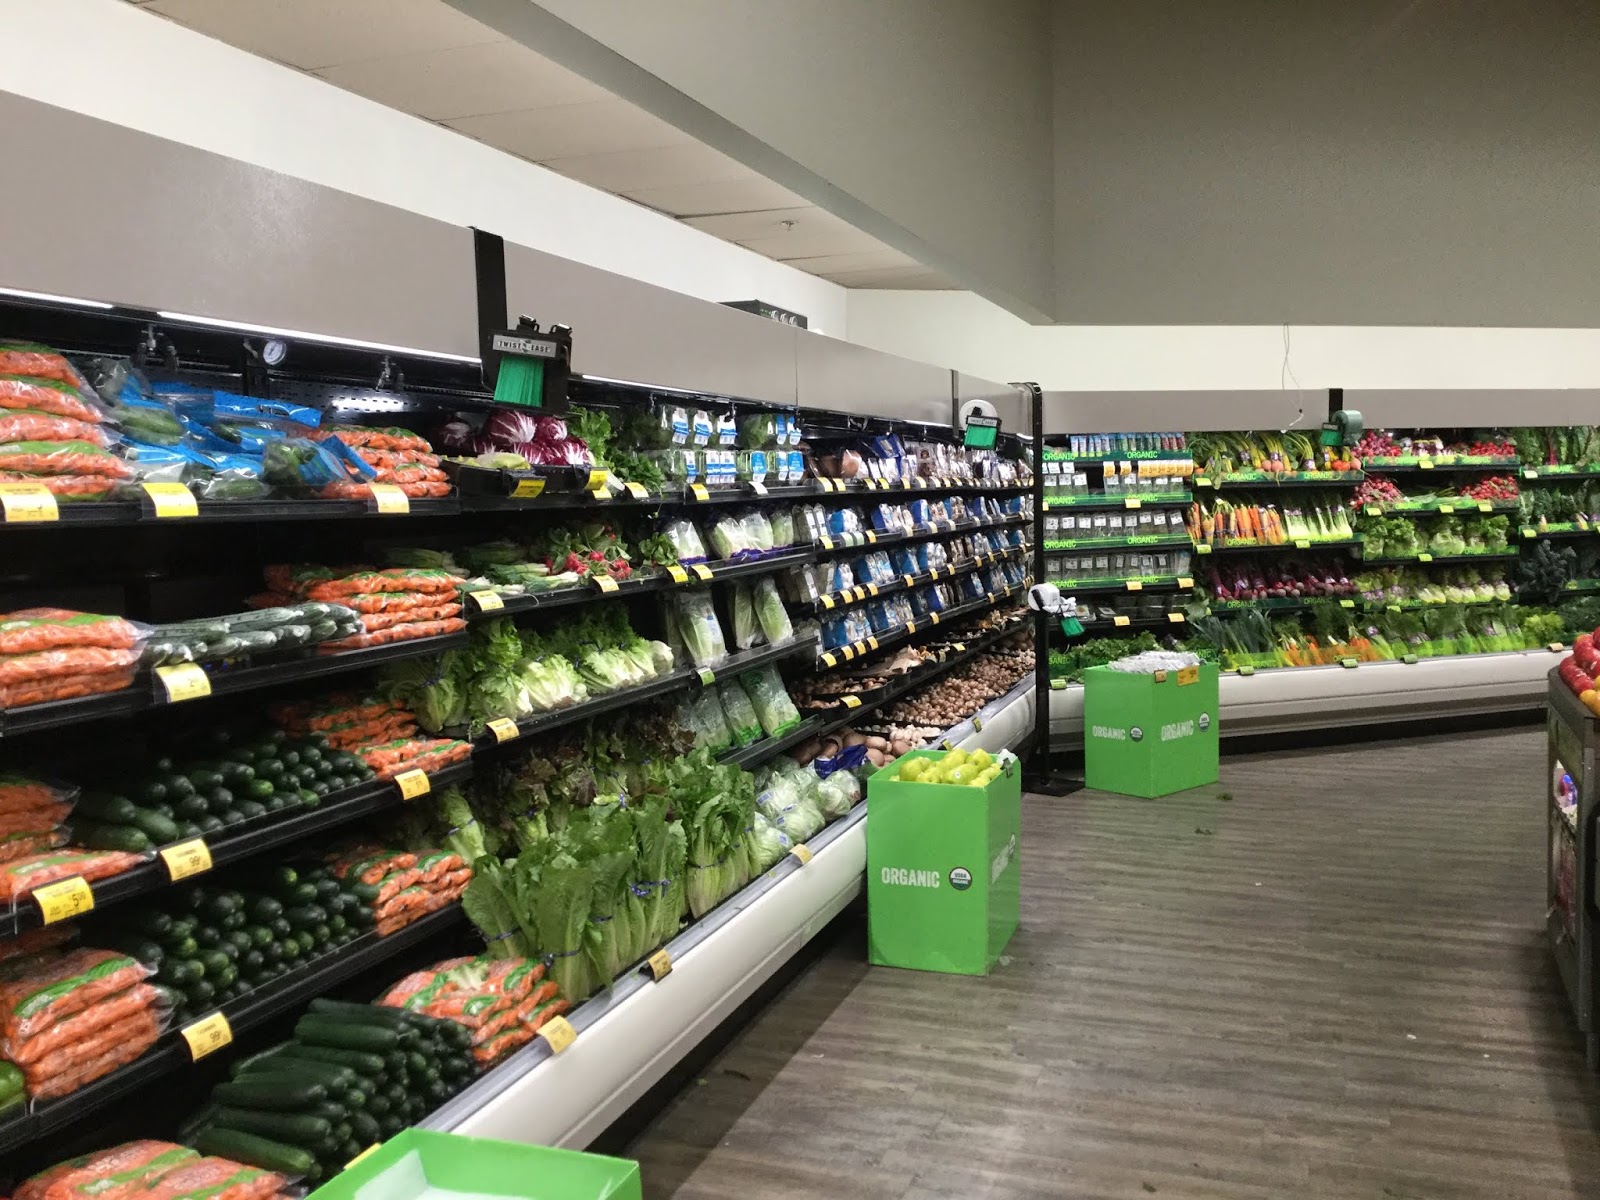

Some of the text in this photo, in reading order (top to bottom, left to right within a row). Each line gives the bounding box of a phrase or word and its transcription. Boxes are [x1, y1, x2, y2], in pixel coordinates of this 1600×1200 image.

[498, 340, 549, 354] TWIST EASE
[1043, 451, 1158, 461] ORGANIC ORGANIC
[1226, 473, 1256, 481] ORGANIC
[1044, 535, 1158, 549] ORGANIC ORGANIC
[1226, 538, 1256, 546] ORGANIC
[1092, 725, 1126, 740] ORGANIC
[1161, 720, 1194, 742] ORGANIC
[882, 867, 940, 888] ORGANIC
